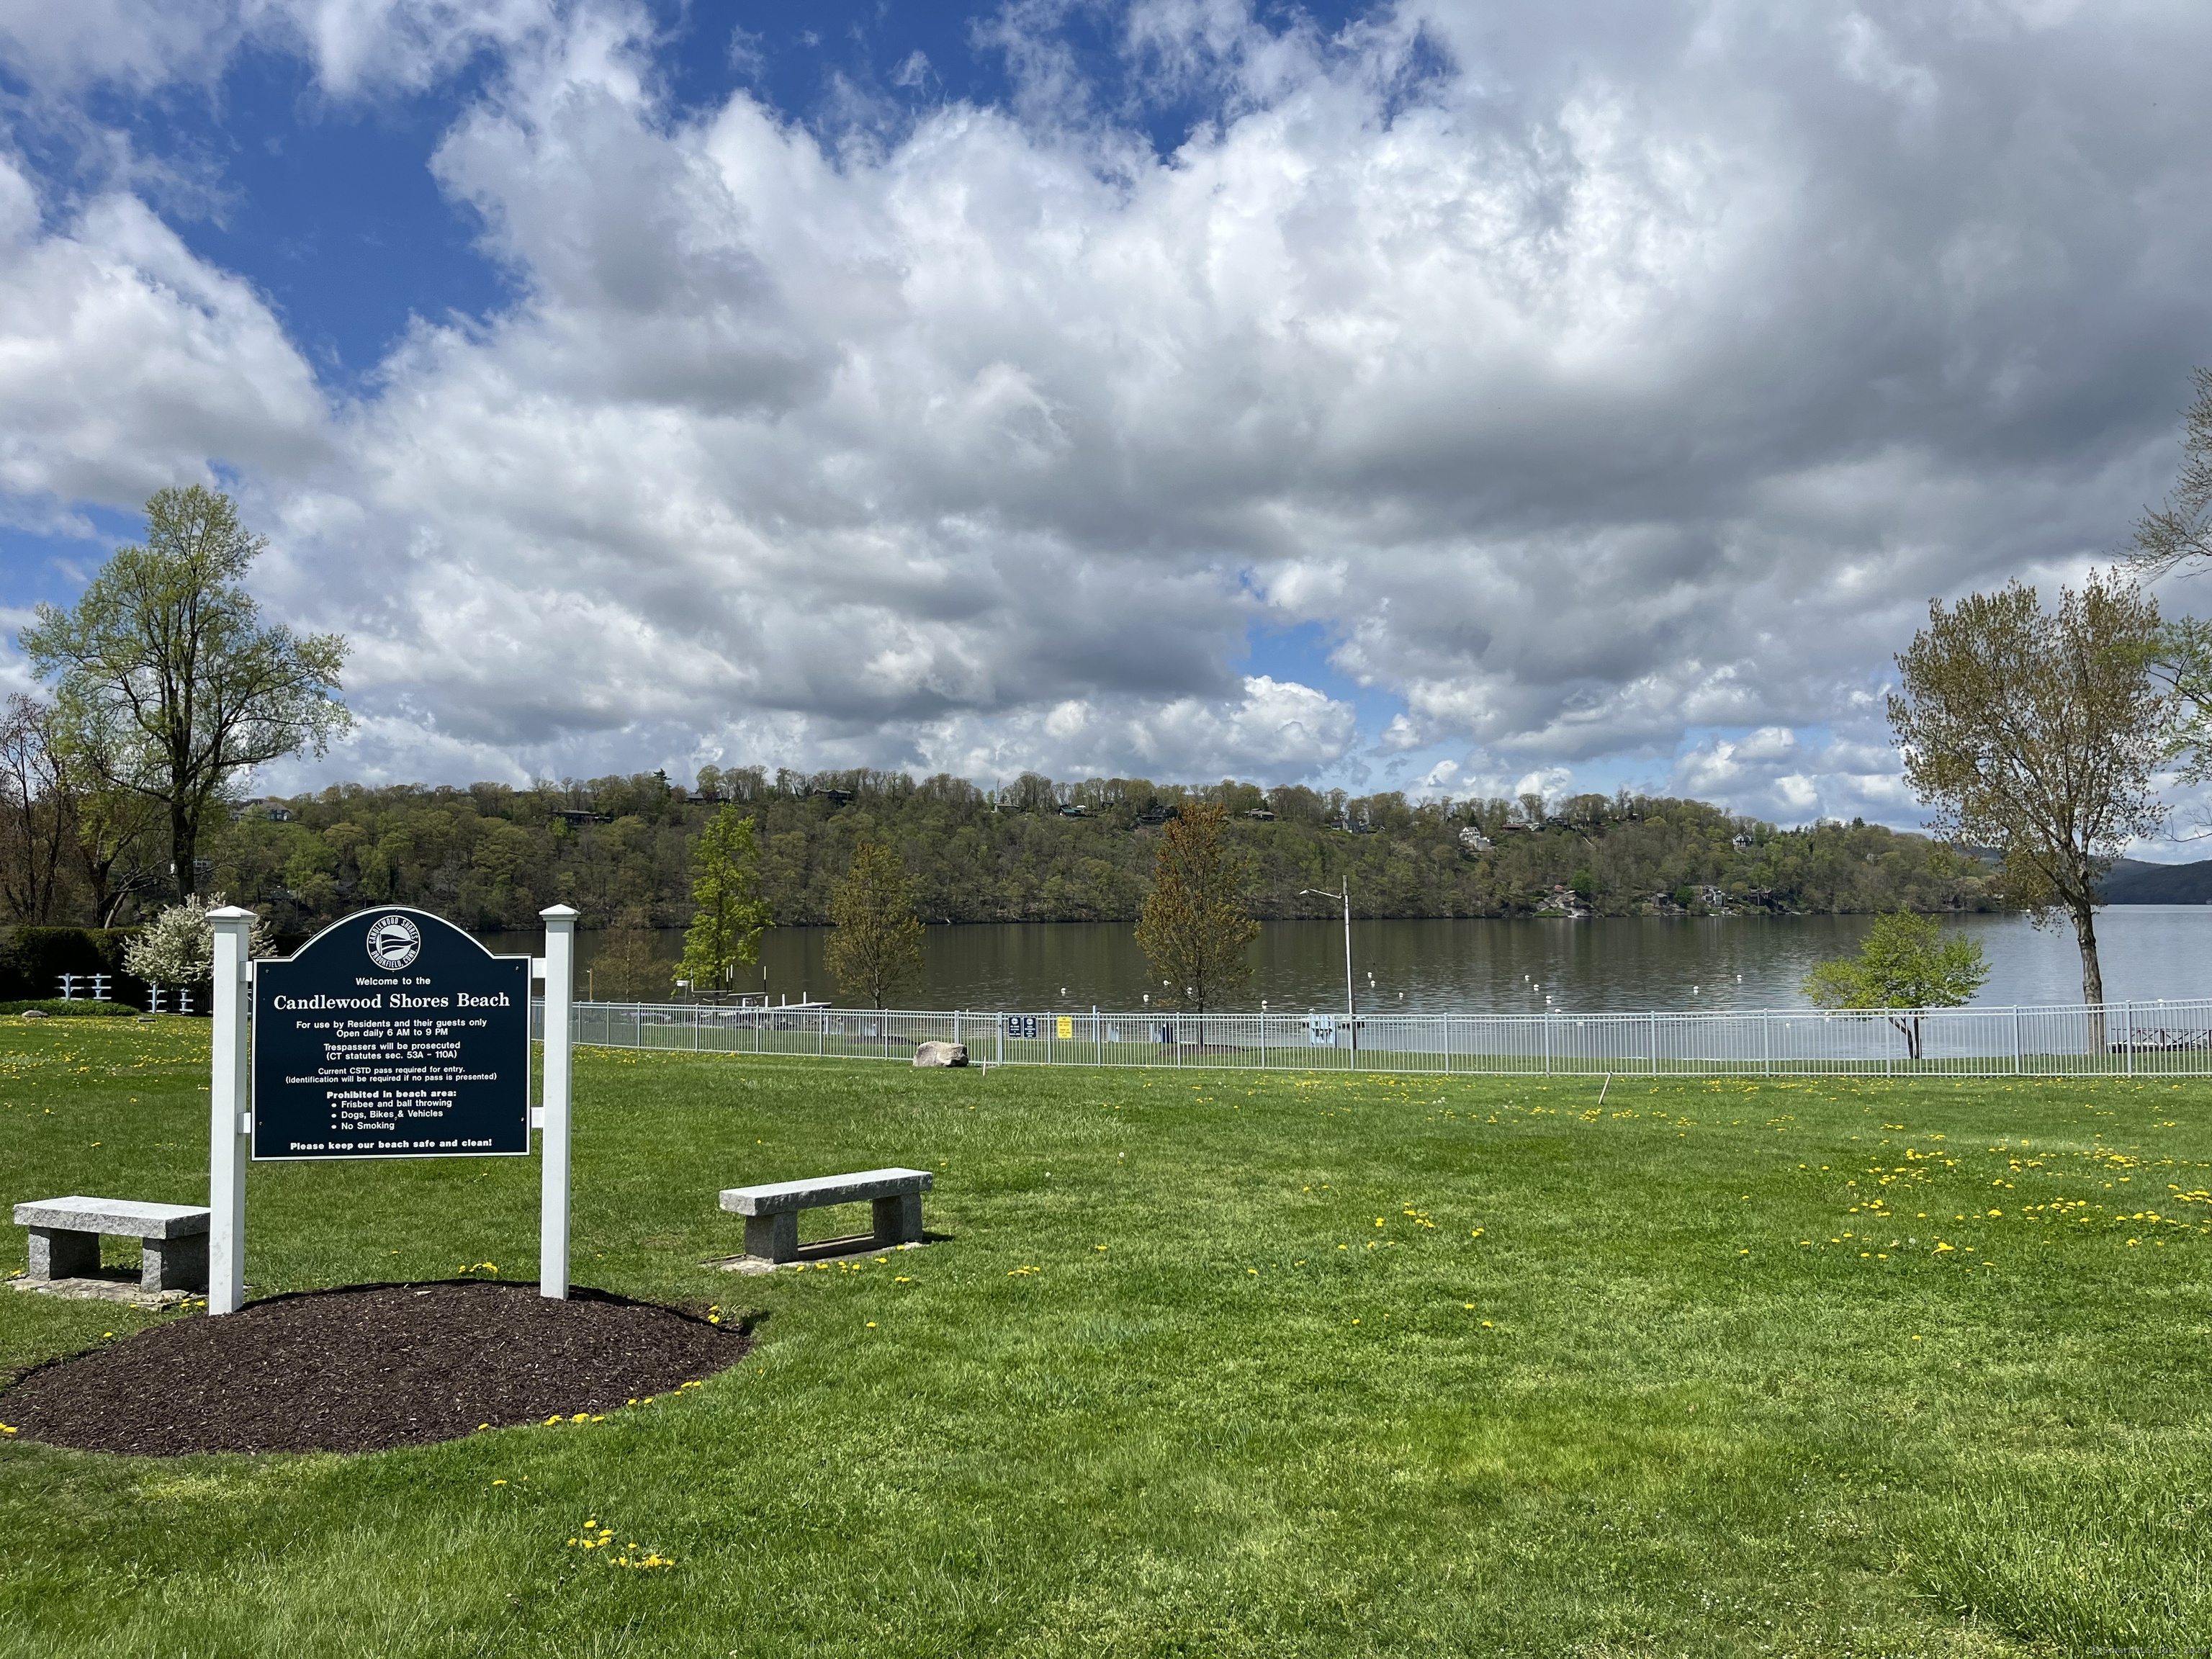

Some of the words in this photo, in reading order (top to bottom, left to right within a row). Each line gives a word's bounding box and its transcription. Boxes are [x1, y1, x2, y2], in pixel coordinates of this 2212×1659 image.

[369, 917, 399, 944] CANDLEWOOD
[401, 920, 418, 940] SHORES
[355, 976, 398, 985] Welcome
[274, 993, 382, 1010] Candlewood
[390, 992, 449, 1008] Shores
[457, 992, 510, 1007] Beach
[333, 1020, 344, 1029] by
[347, 1020, 391, 1028] Residents
[394, 1019, 410, 1028] and
[413, 1018, 433, 1028] their
[436, 1019, 466, 1028] guests
[469, 1018, 487, 1027] only
[363, 1028, 383, 1038] daily
[323, 1043, 376, 1052] Trespassers
[411, 1041, 460, 1051] prosecuted
[326, 1051, 343, 1061] (CT
[435, 1050, 457, 1058] 110A)
[395, 1066, 426, 1075] required
[369, 1074, 401, 1083] required
[455, 1072, 497, 1082] presented)
[326, 1090, 379, 1099] Prohibited
[341, 1100, 374, 1108] Frisbee
[415, 1098, 451, 1108] throwing
[341, 1110, 366, 1120] Dogs,
[407, 1109, 443, 1118] Vehicles
[356, 1121, 395, 1130] Smoking
[328, 1141, 354, 1150] keep
[413, 1139, 435, 1148] safe
[439, 1138, 457, 1147] and
